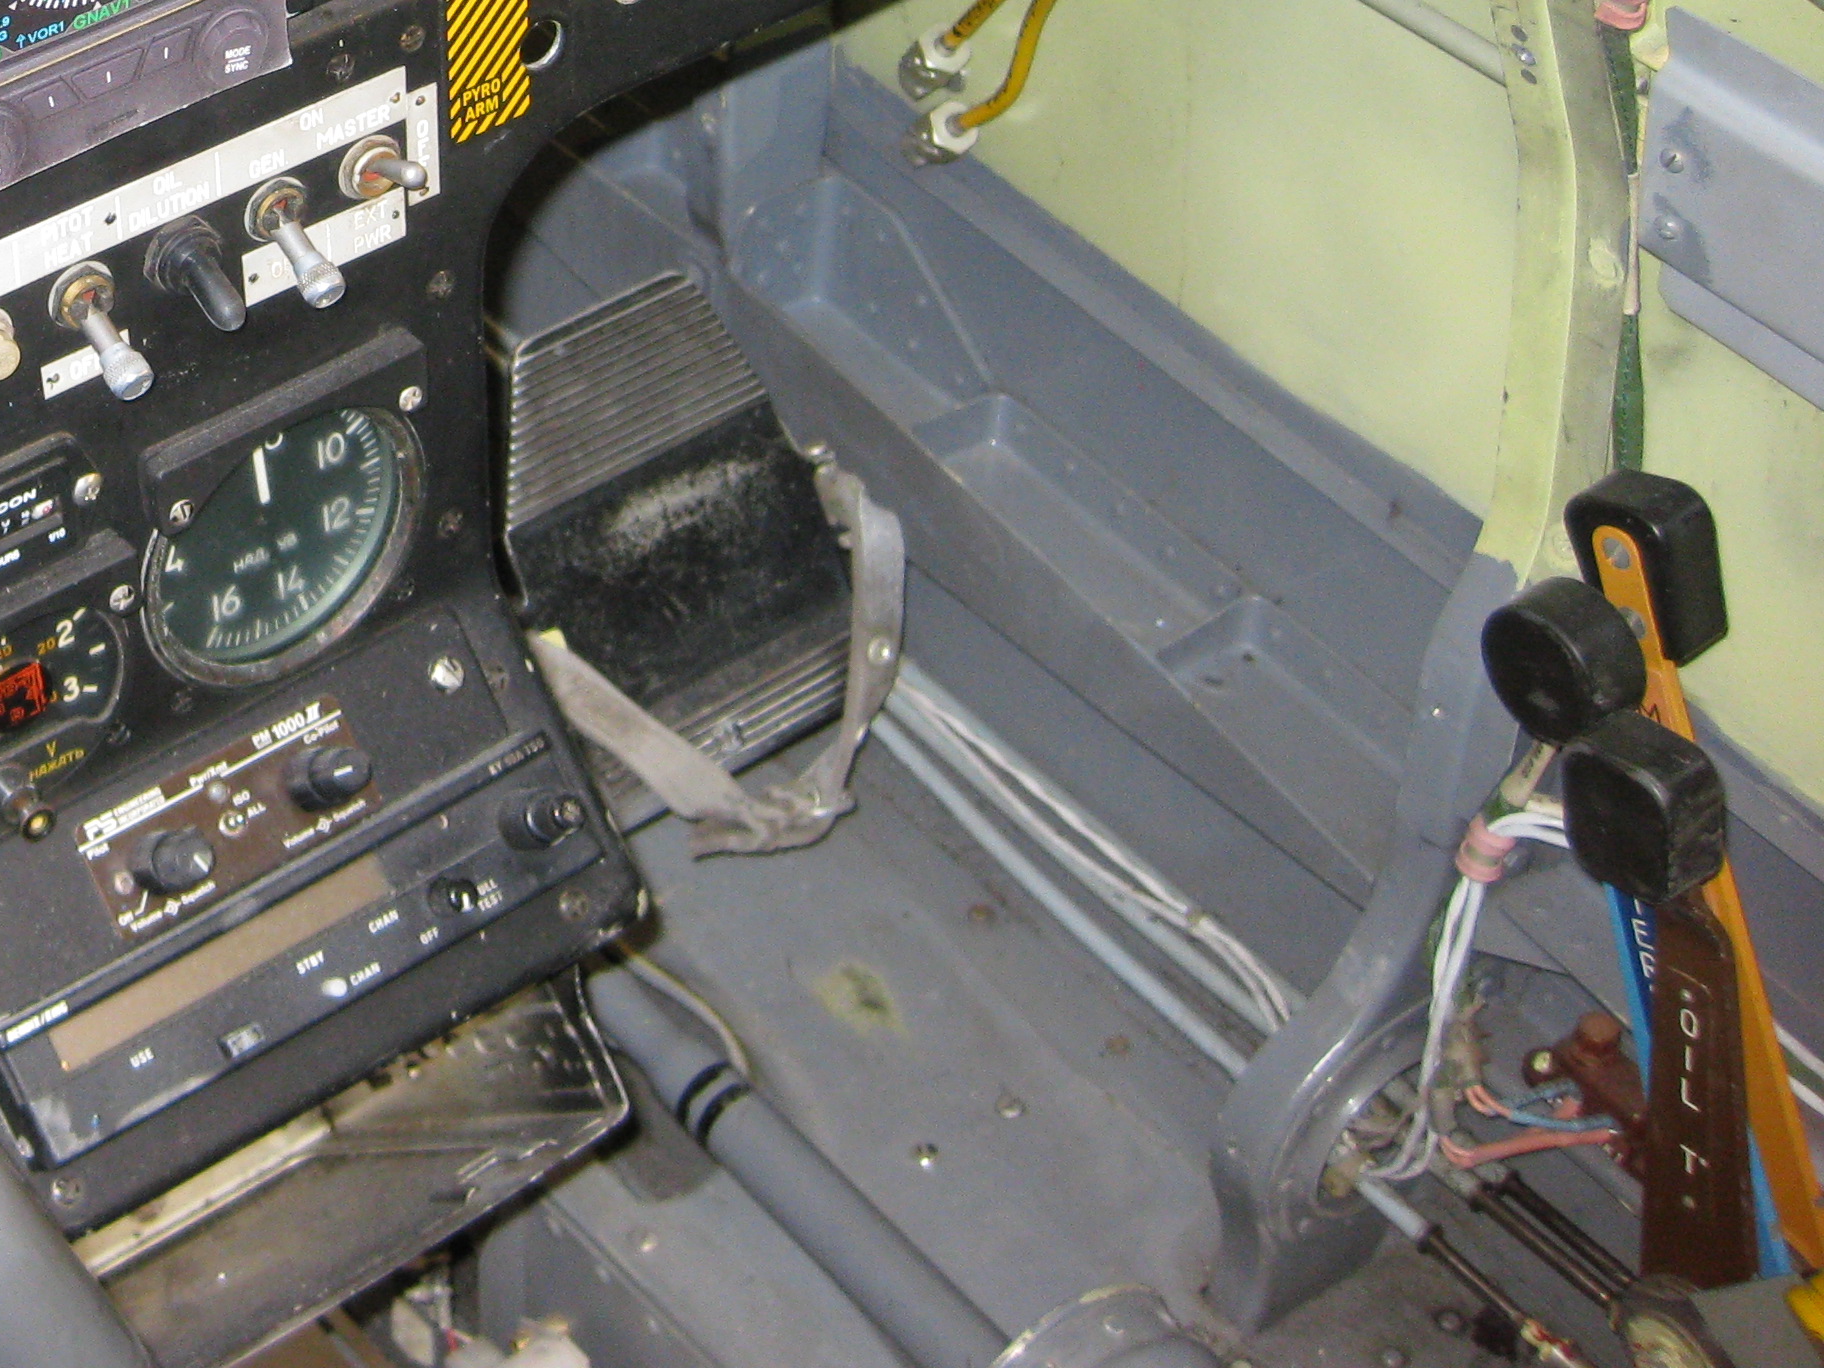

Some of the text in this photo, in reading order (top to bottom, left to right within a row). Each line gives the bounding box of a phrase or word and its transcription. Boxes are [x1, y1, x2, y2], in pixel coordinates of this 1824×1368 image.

[28, 21, 64, 44] VOR1
[225, 45, 251, 59] MODE
[225, 59, 249, 74] SYNC
[463, 79, 501, 106] PYRO
[299, 108, 324, 131] ON
[465, 95, 499, 122] ARM
[316, 105, 391, 151] MASTER
[249, 149, 288, 179] GEN.
[153, 173, 182, 195] OIL
[129, 183, 209, 232] DILUTION
[354, 201, 388, 229] EXT
[40, 206, 95, 246] PITOT
[354, 225, 391, 253] PWR
[44, 231, 94, 269] HEAT
[318, 432, 345, 470] 10
[323, 497, 350, 531] 12
[165, 545, 185, 573] 4
[278, 565, 306, 600] 14
[212, 585, 241, 622] 16
[37, 636, 56, 655] 20
[56, 619, 75, 648] 2
[63, 676, 79, 702] 3
[252, 712, 304, 749] PM 1000
[232, 790, 250, 806] ISO
[247, 803, 267, 818] ALL
[477, 891, 503, 911] TEST
[368, 909, 399, 934] CHAN
[420, 927, 439, 944] OFF
[296, 950, 324, 975] STBY
[350, 962, 381, 986] CHAN
[130, 1047, 154, 1068] USE
[1680, 1007, 1701, 1112] OIL
